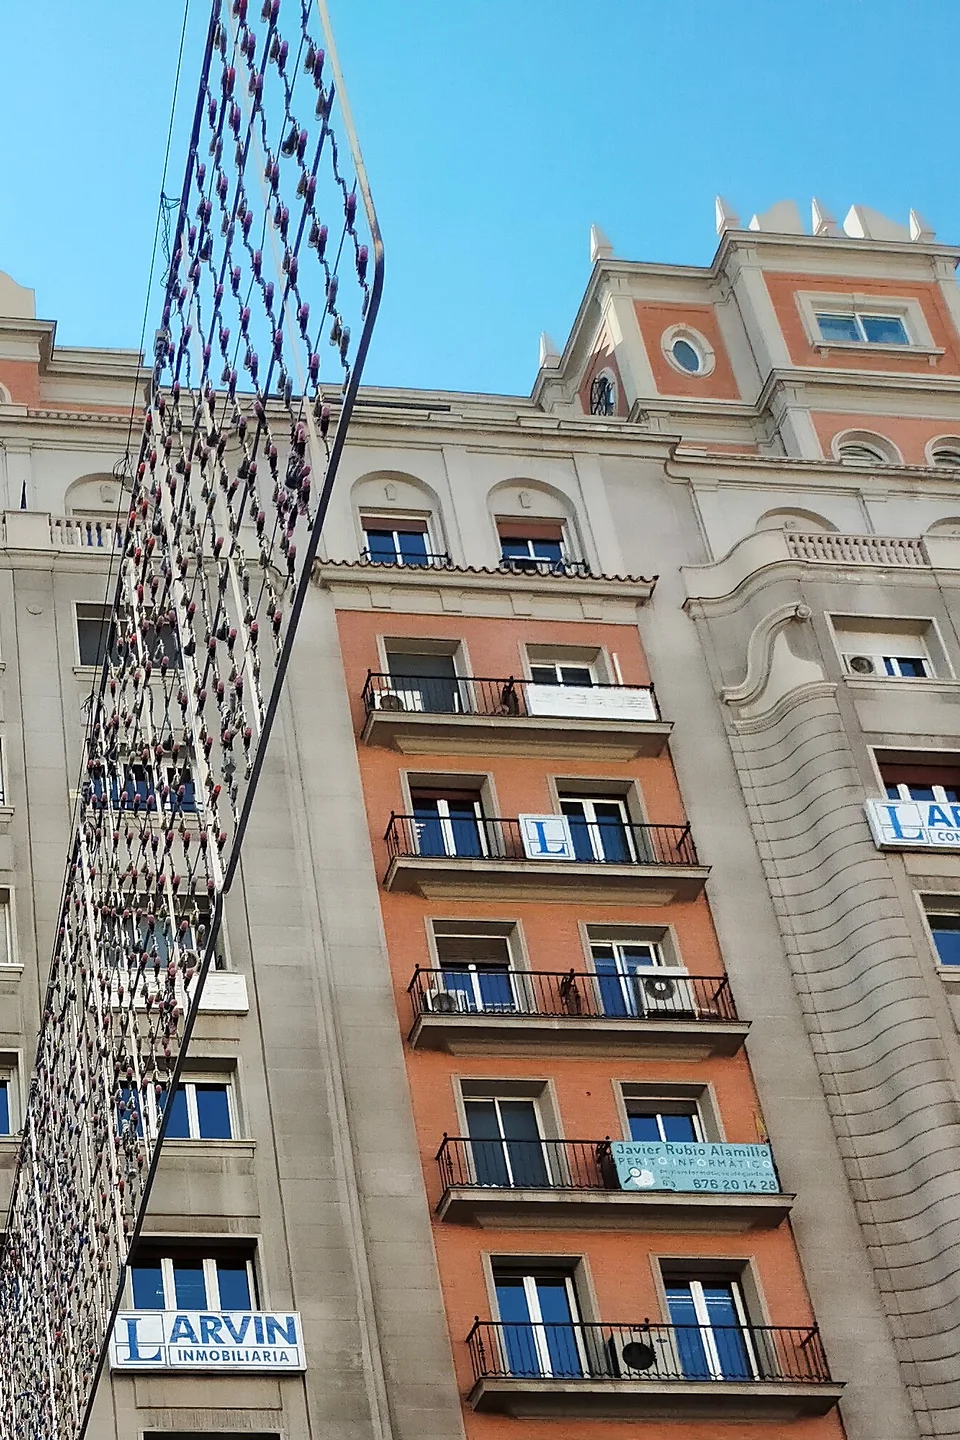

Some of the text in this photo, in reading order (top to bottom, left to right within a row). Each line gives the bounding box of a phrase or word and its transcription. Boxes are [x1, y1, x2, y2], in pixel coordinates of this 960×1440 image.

[531, 821, 566, 855] L
[616, 1144, 660, 1155] Javier
[666, 1144, 706, 1156] Rubio
[723, 1179, 740, 1191] 20
[760, 1180, 778, 1192] 28
[177, 1348, 290, 1363] INMOBILIARIA
